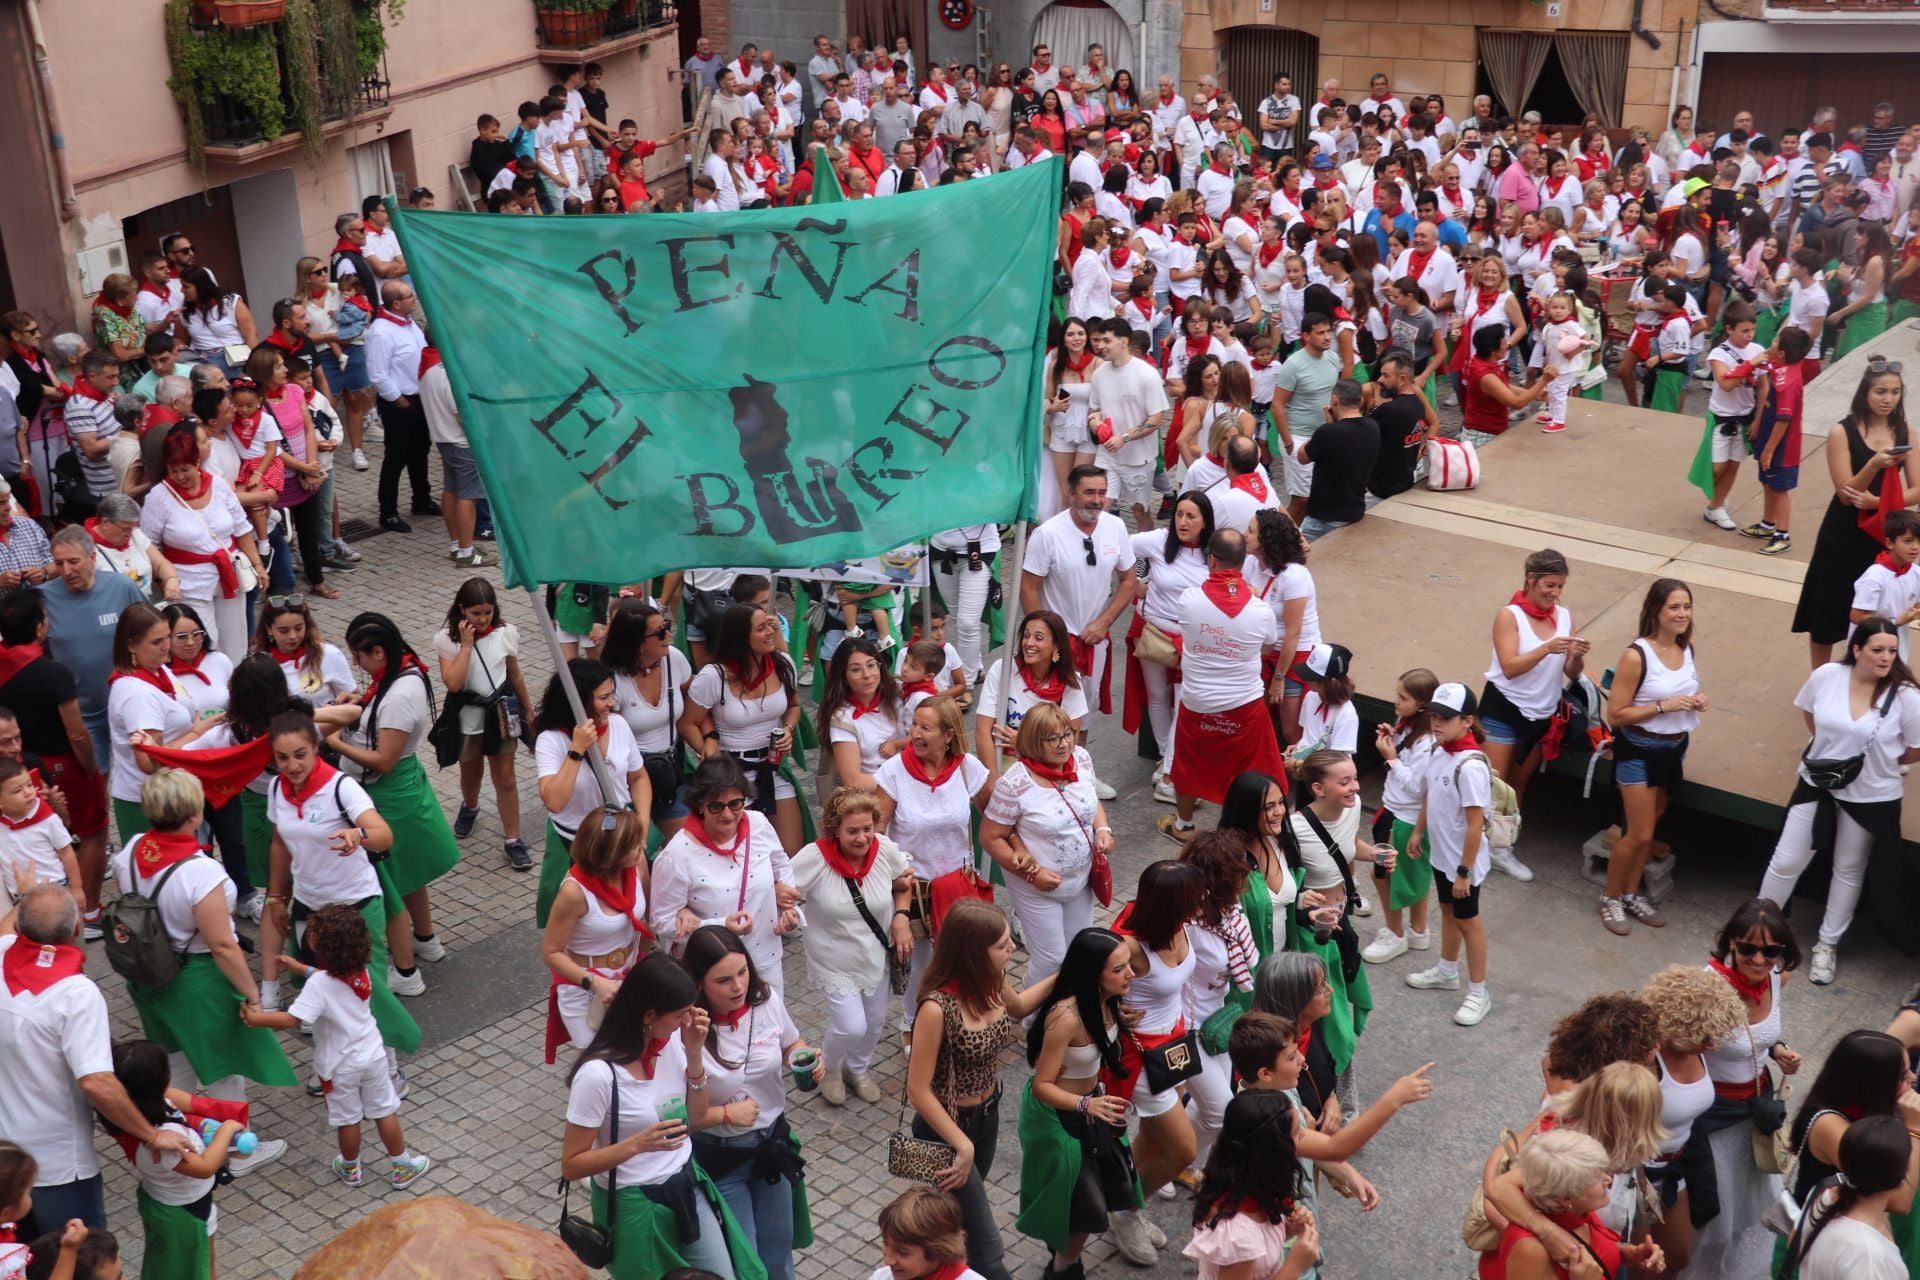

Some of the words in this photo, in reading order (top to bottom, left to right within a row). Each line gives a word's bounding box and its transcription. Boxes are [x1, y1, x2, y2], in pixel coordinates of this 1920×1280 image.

[1550, 6, 1557, 16] 6
[578, 218, 925, 337] PEÑA
[1675, 341, 1687, 350] 14
[530, 368, 653, 511] EL
[675, 335, 1006, 538] BUREO
[1199, 622, 1227, 636] Peña
